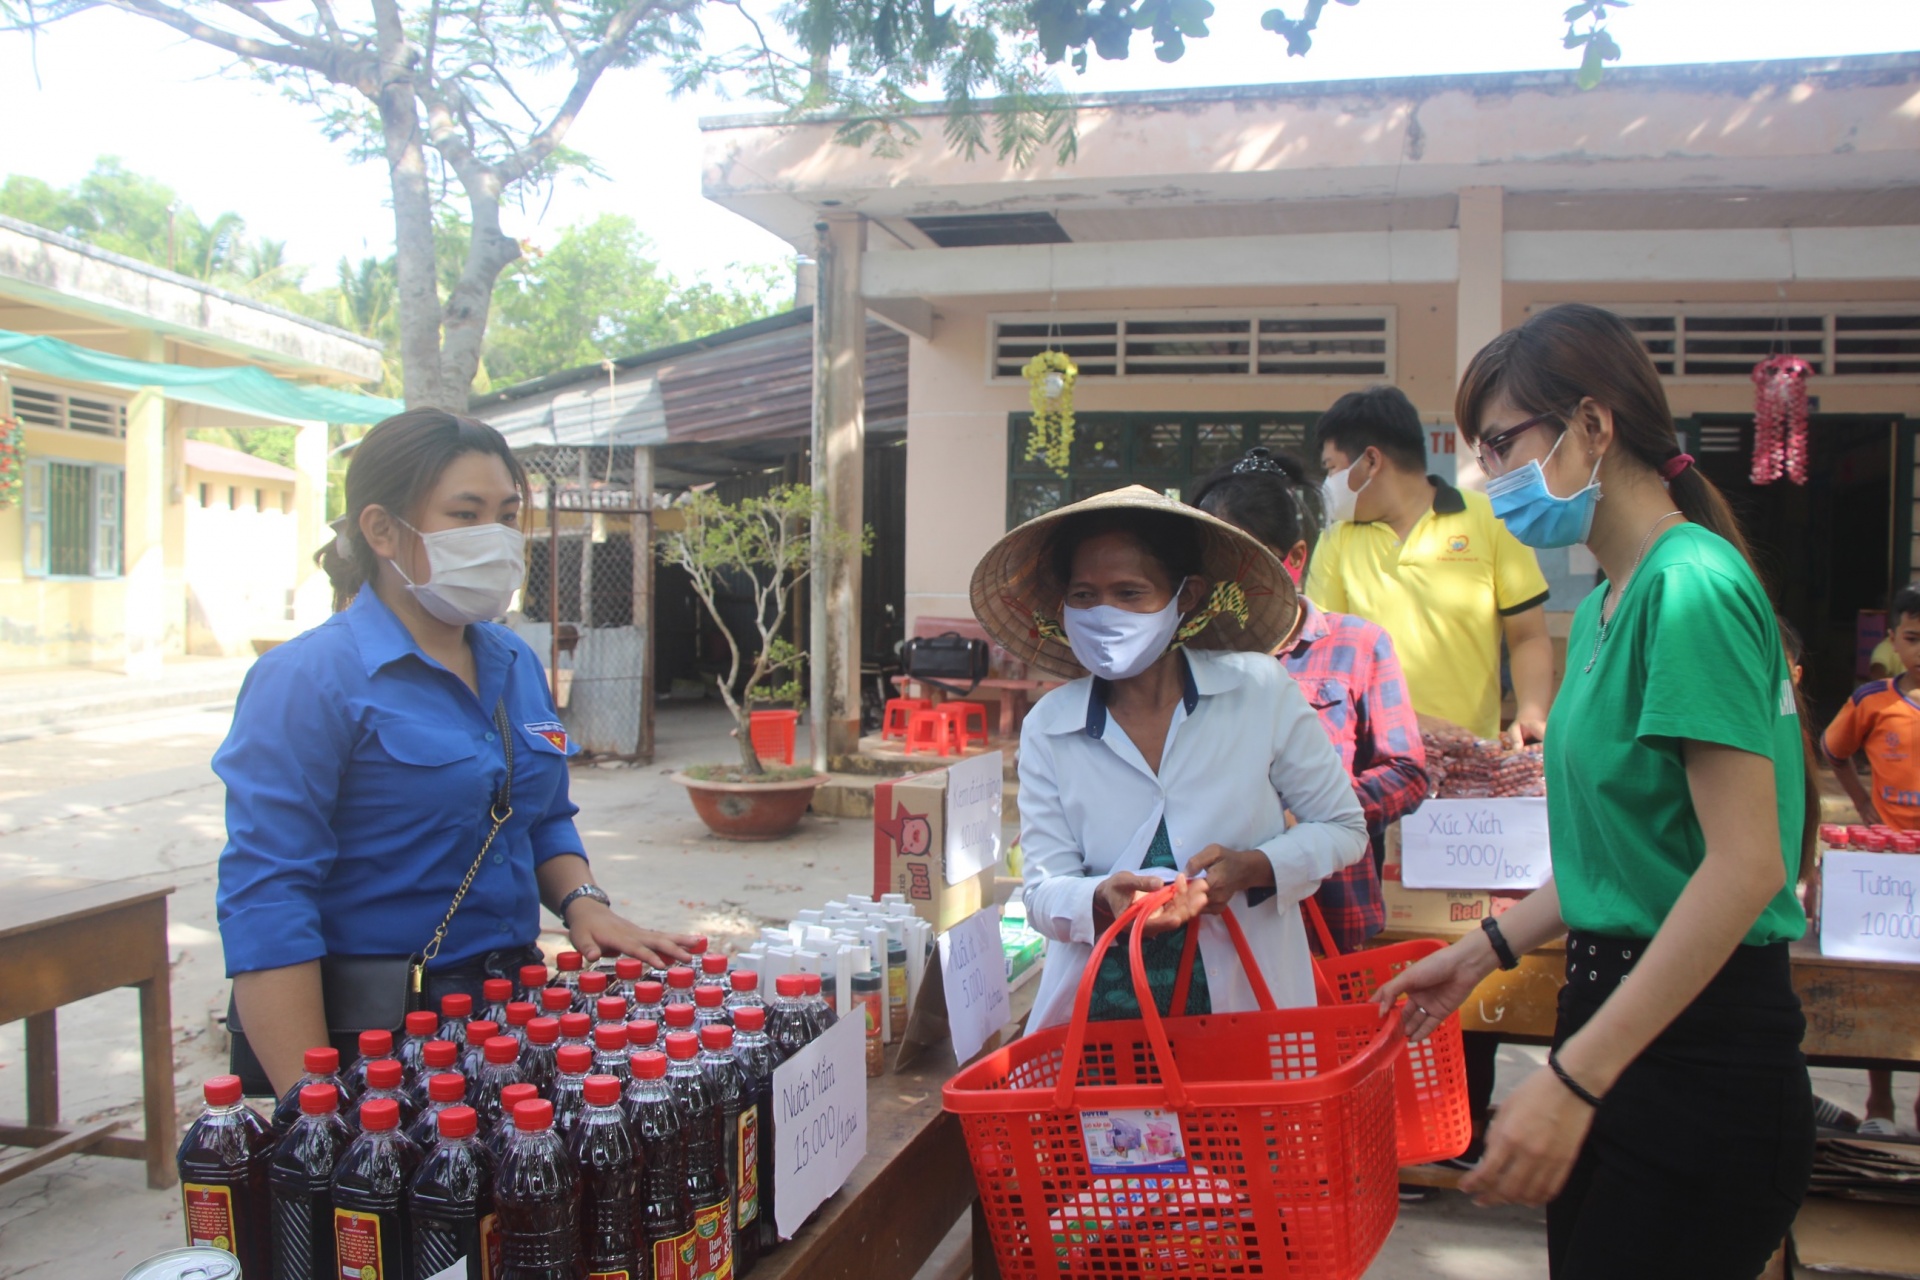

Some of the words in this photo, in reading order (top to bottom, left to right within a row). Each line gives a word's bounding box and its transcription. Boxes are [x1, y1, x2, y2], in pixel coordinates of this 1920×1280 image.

[1428, 812, 1462, 836] Xúc
[1465, 809, 1503, 835] Xích
[907, 862, 932, 901] Red
[1450, 900, 1483, 922] Red
[783, 1072, 811, 1124] Nước
[811, 1055, 835, 1101] Mắm
